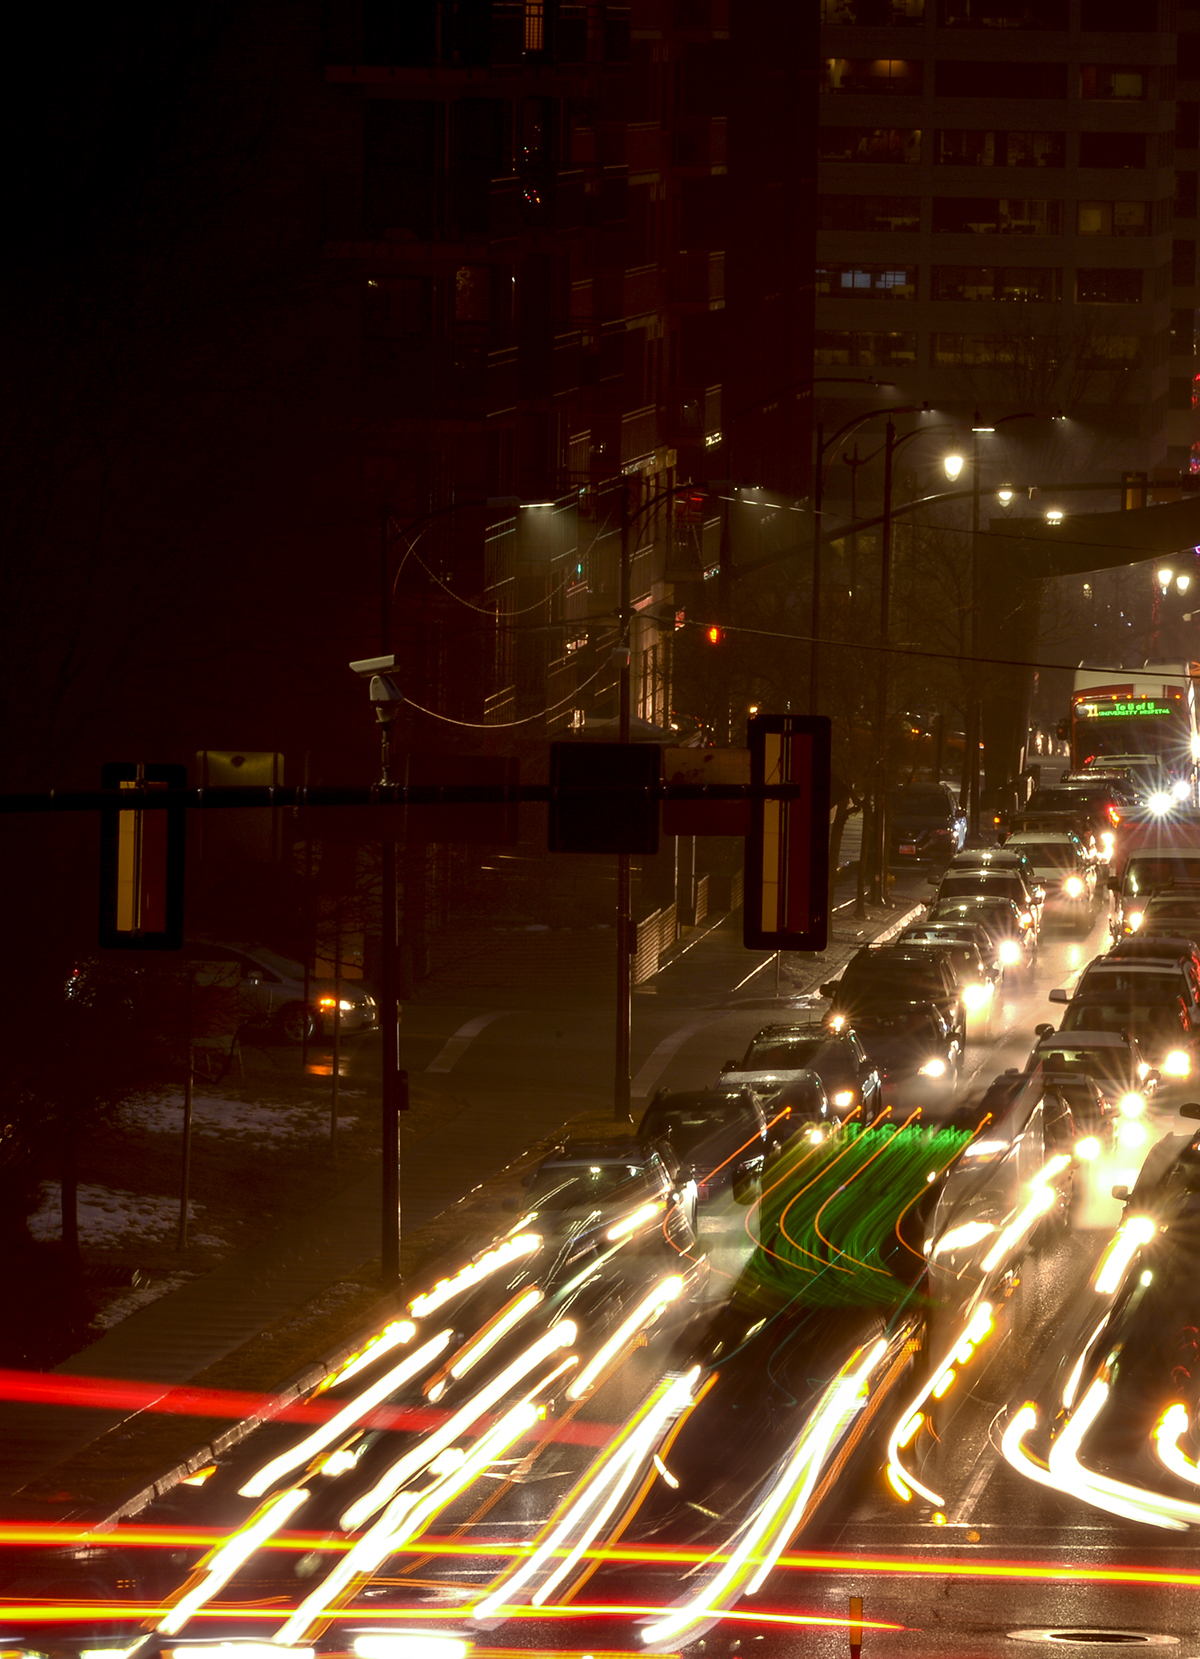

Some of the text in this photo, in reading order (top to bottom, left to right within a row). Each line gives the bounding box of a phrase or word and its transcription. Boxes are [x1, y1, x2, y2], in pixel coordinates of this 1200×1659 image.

[1115, 703, 1126, 711] To
[1136, 702, 1146, 710] of
[1147, 702, 1154, 710] U
